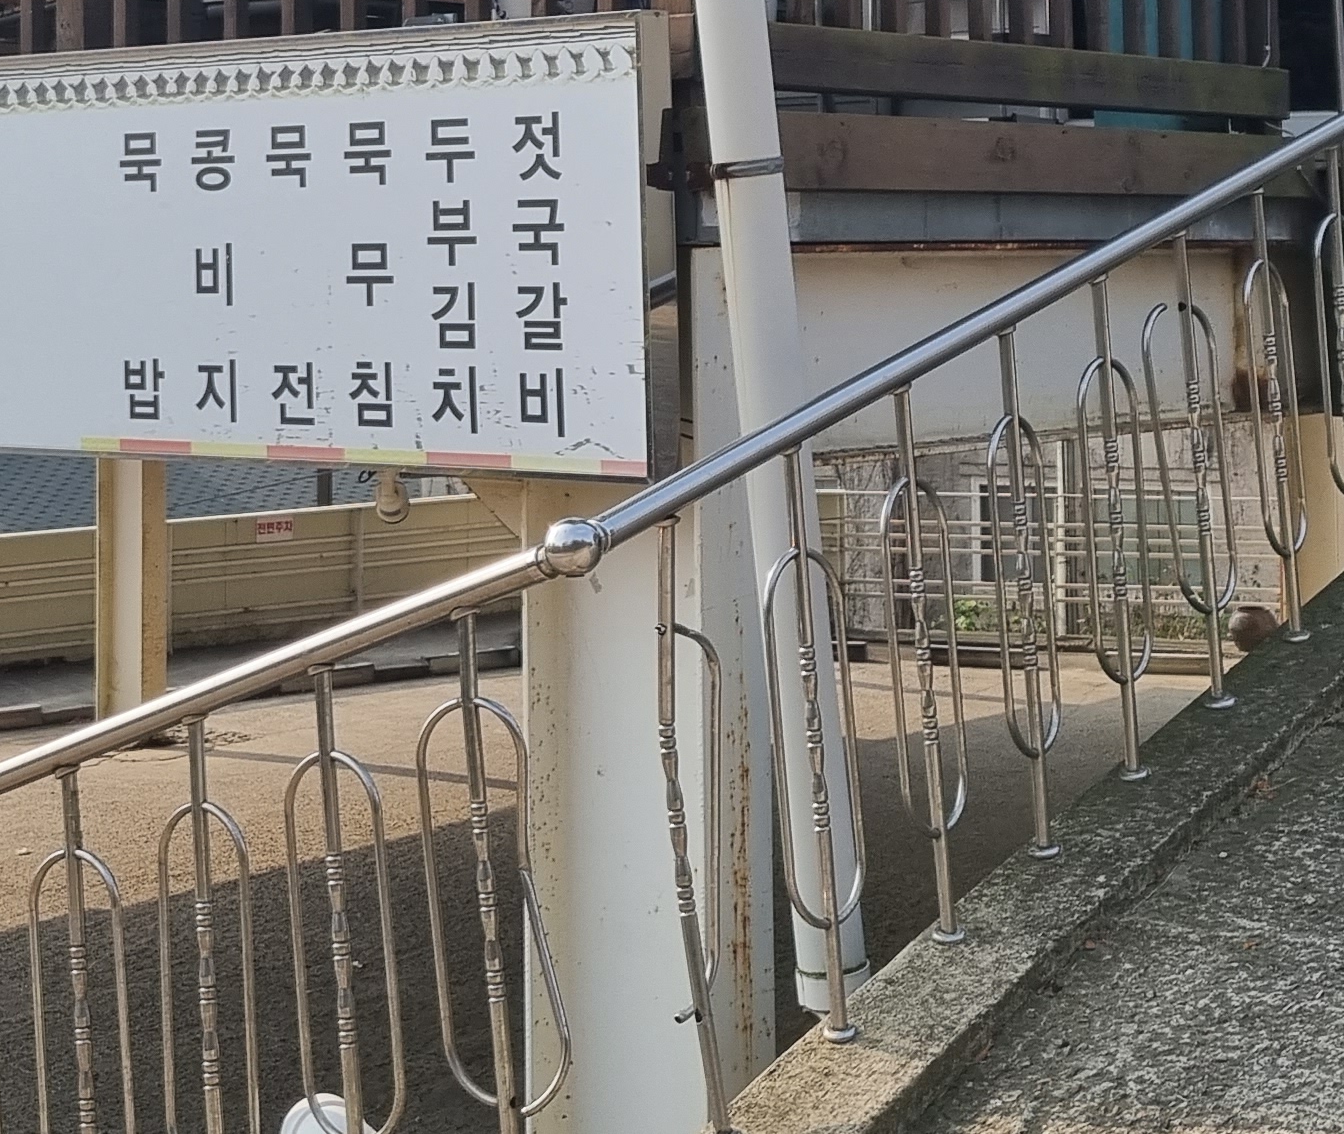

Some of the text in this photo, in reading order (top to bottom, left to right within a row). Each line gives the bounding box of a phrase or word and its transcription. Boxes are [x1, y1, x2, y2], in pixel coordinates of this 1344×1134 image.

[119, 131, 165, 422] 묵밥
[190, 128, 239, 424] 콩비지
[265, 124, 317, 427] 묵전
[343, 120, 395, 429] 묵무침
[424, 117, 479, 435] 두부김치
[511, 110, 568, 439] 젓국갈비
